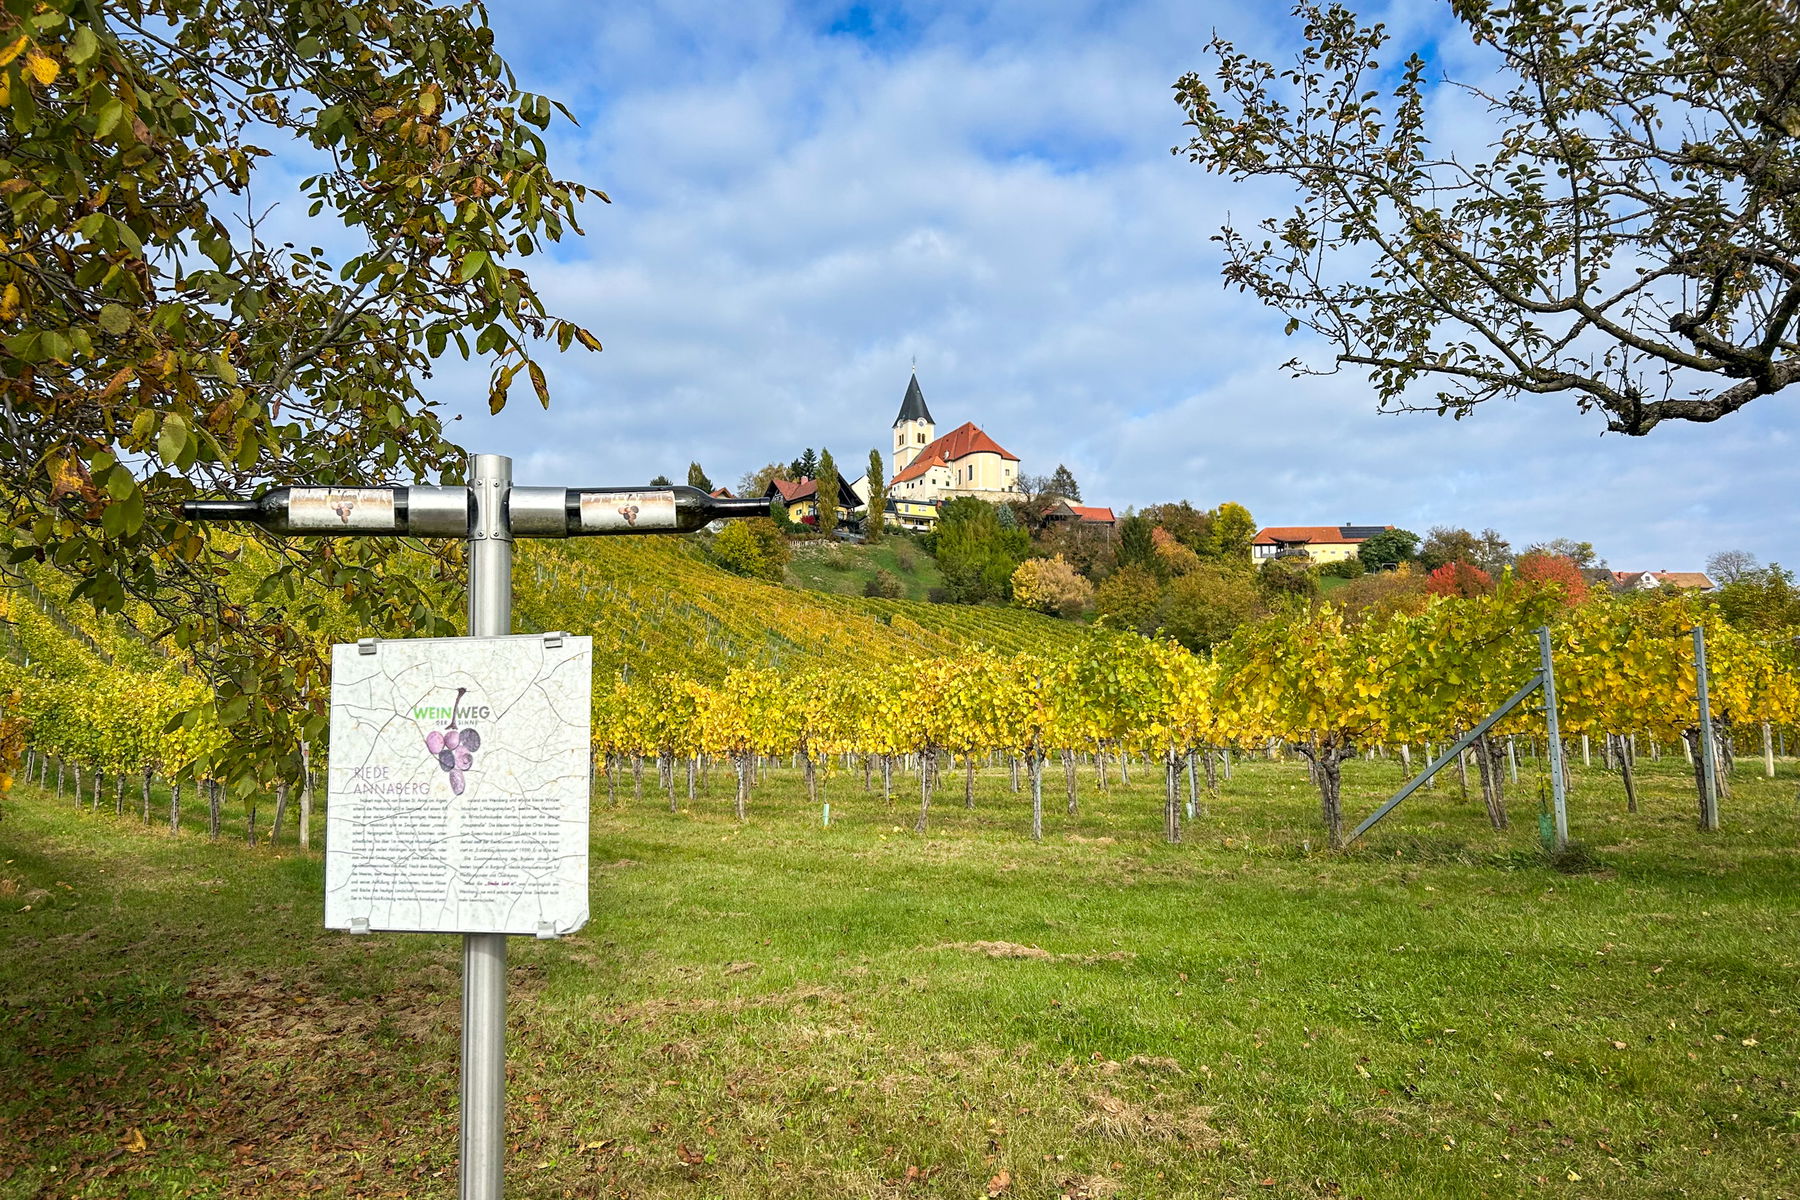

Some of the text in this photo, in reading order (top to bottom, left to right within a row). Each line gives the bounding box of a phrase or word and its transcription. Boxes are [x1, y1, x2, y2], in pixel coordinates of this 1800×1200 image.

[413, 706, 490, 720] WEIN WEG
[354, 766, 389, 779] RIEDE
[354, 782, 430, 795] ANNABERG
